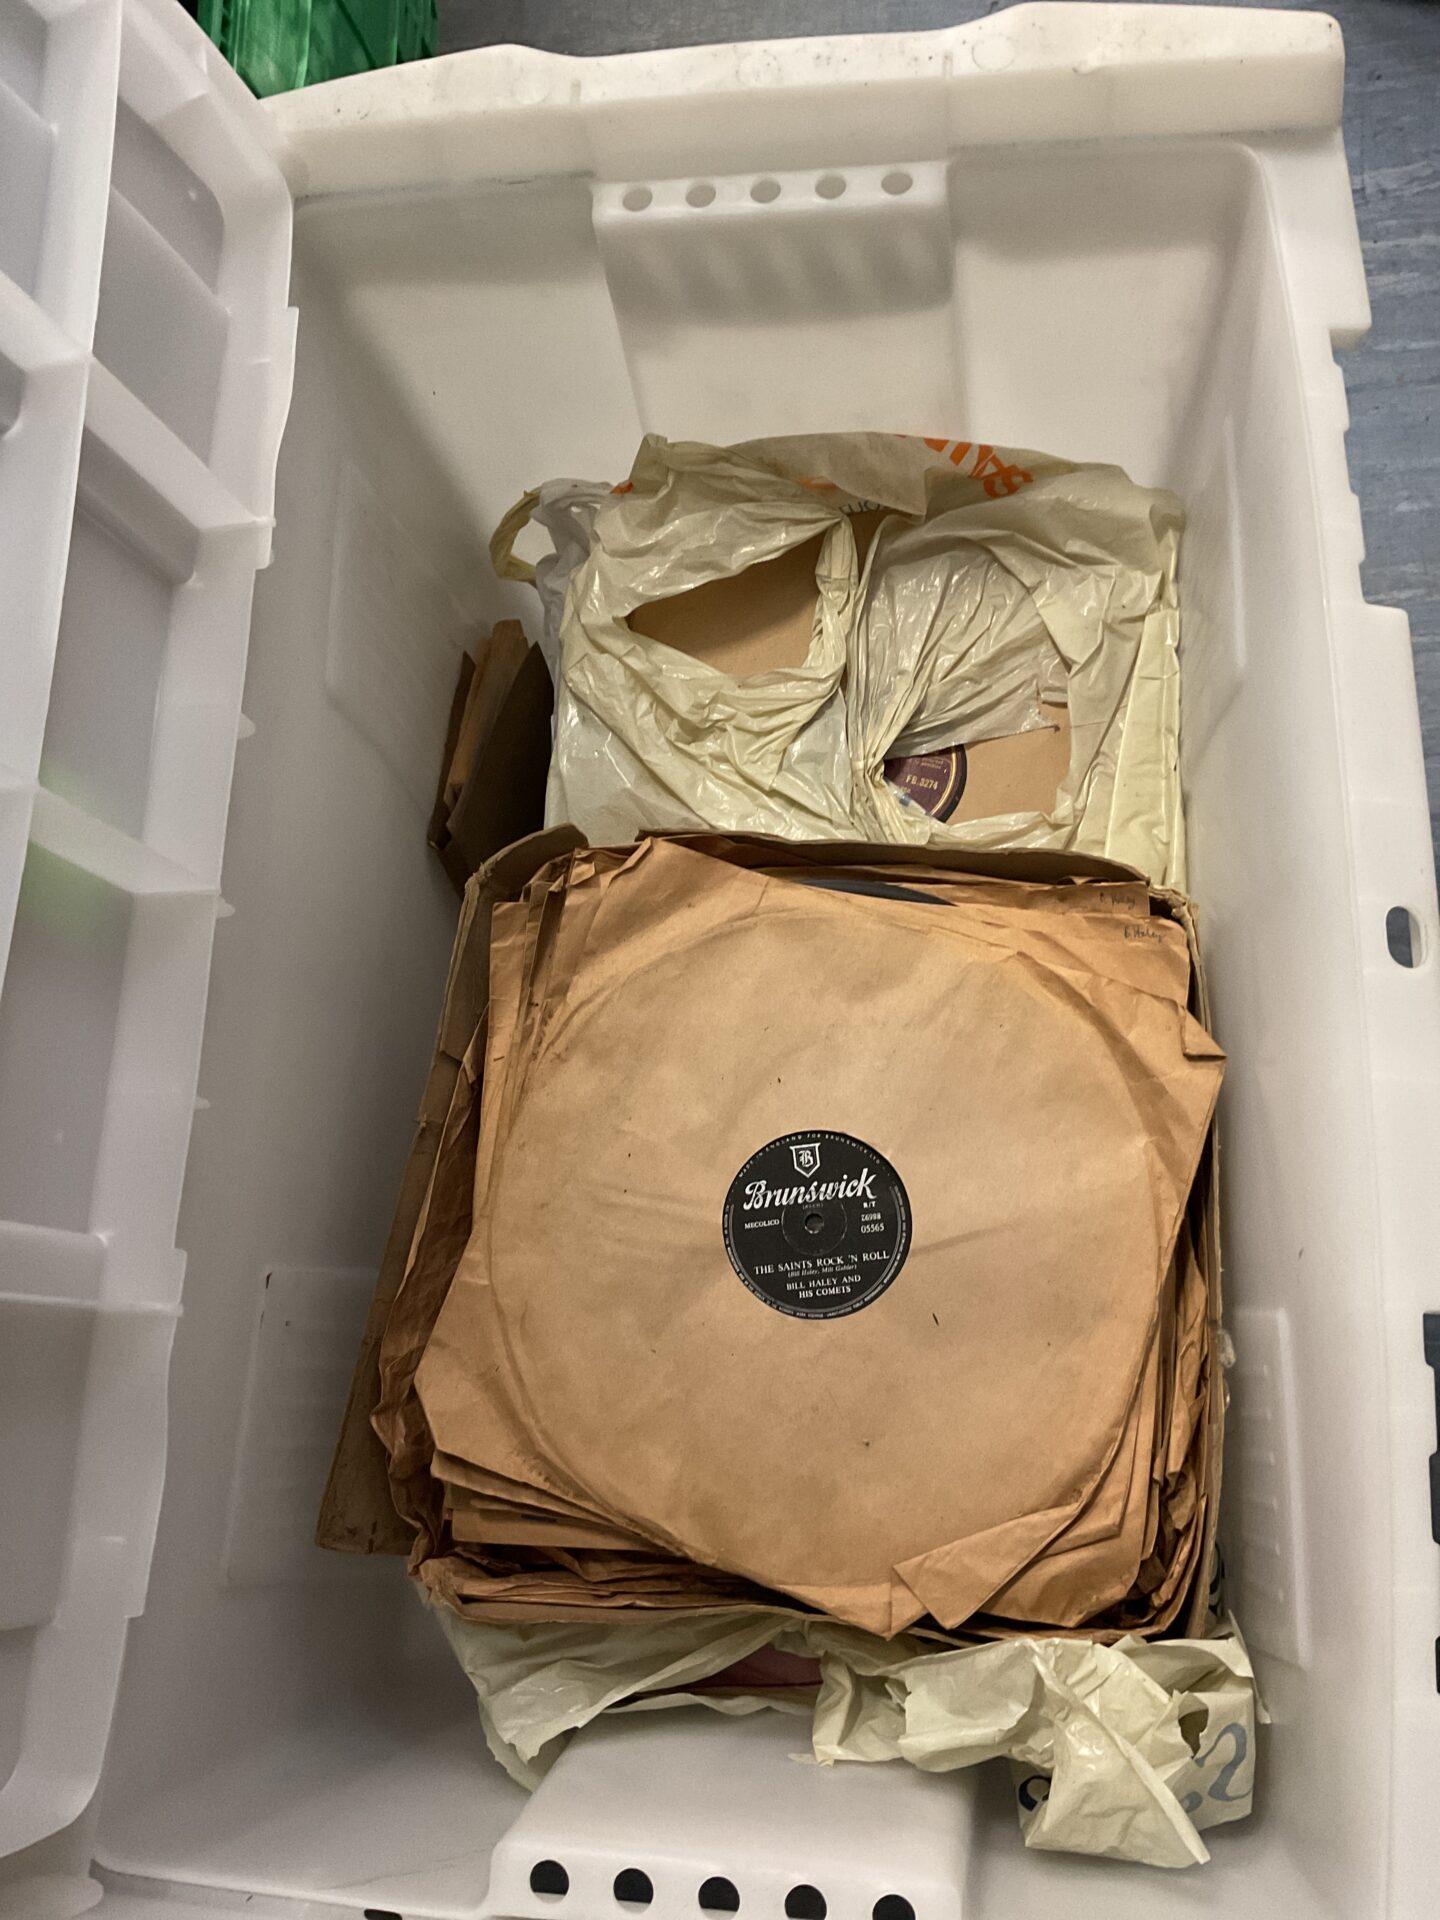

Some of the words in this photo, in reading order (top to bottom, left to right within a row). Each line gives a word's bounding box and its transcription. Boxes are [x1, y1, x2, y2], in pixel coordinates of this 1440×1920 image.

[743, 1167, 878, 1210] Brunswick
[744, 1219, 780, 1230] MECOLICO
[860, 1222, 885, 1234] 05565
[753, 1264, 775, 1276] THE
[778, 1259, 813, 1272] SAINTS
[816, 1255, 844, 1267] ROCK
[862, 1250, 890, 1262] ROLL
[786, 1281, 806, 1291] BILL
[809, 1277, 838, 1289] HALEY
[841, 1274, 862, 1285] AND
[798, 1290, 814, 1299] HIS
[815, 1285, 852, 1298] COMETS
